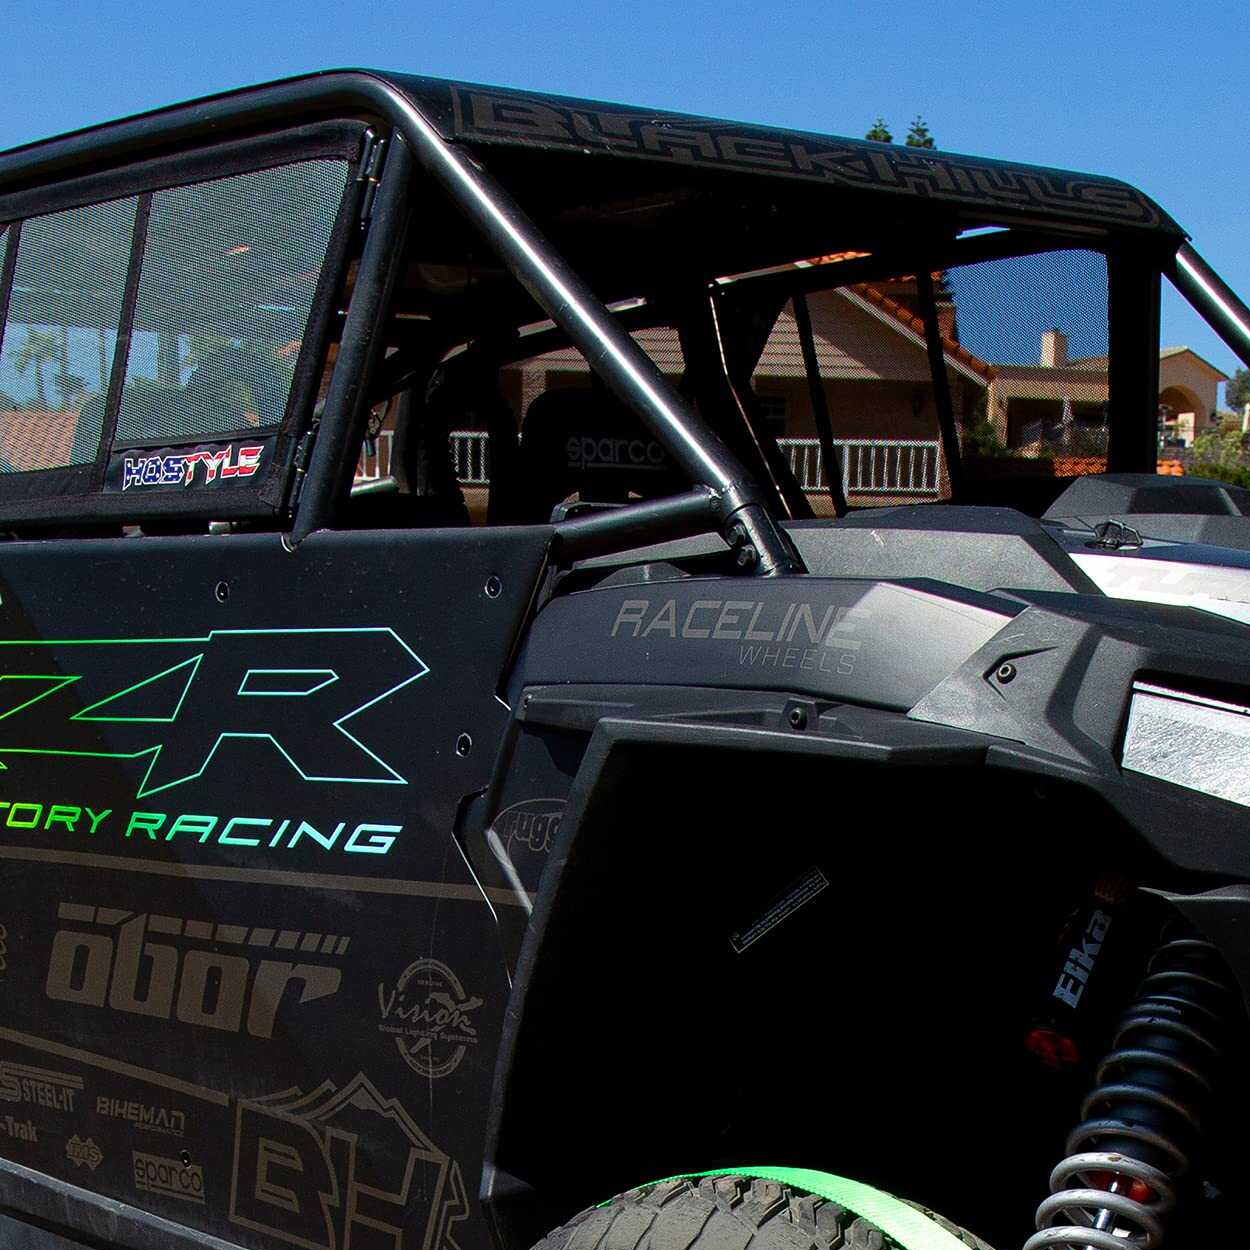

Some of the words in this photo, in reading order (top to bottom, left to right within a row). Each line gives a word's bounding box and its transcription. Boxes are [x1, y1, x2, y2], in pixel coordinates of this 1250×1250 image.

[122, 444, 264, 491] HOSTYLE
[610, 599, 871, 651] RACELINE
[738, 645, 858, 676] WHEELS
[124, 809, 405, 855] RACING
[134, 1158, 203, 1192] sparco
